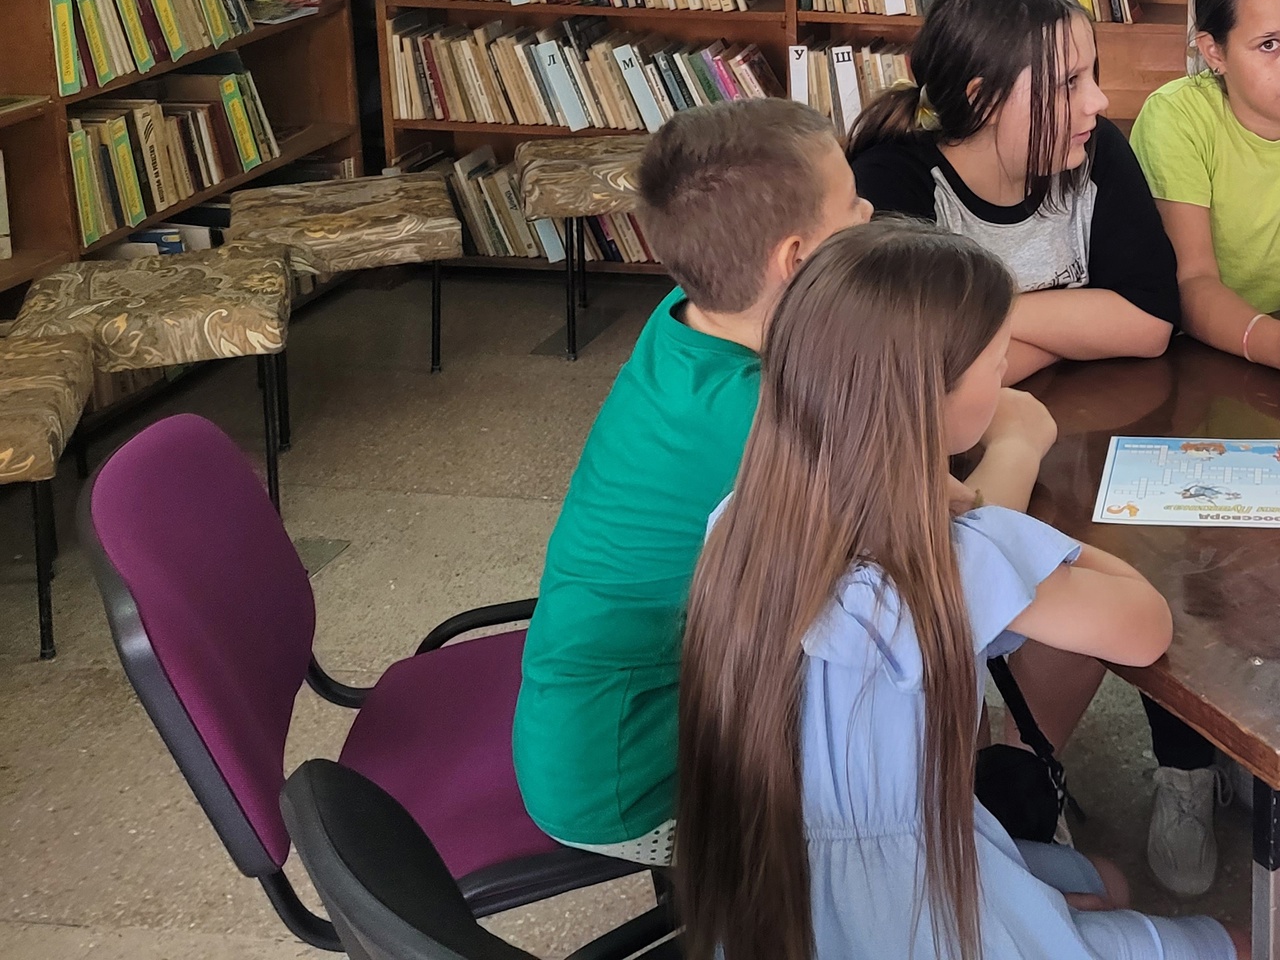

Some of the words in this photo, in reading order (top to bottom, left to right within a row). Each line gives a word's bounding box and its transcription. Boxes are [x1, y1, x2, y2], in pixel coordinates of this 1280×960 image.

[547, 54, 558, 67] Л
[794, 49, 805, 60] У
[835, 50, 852, 63] Ш
[622, 56, 634, 69] М
